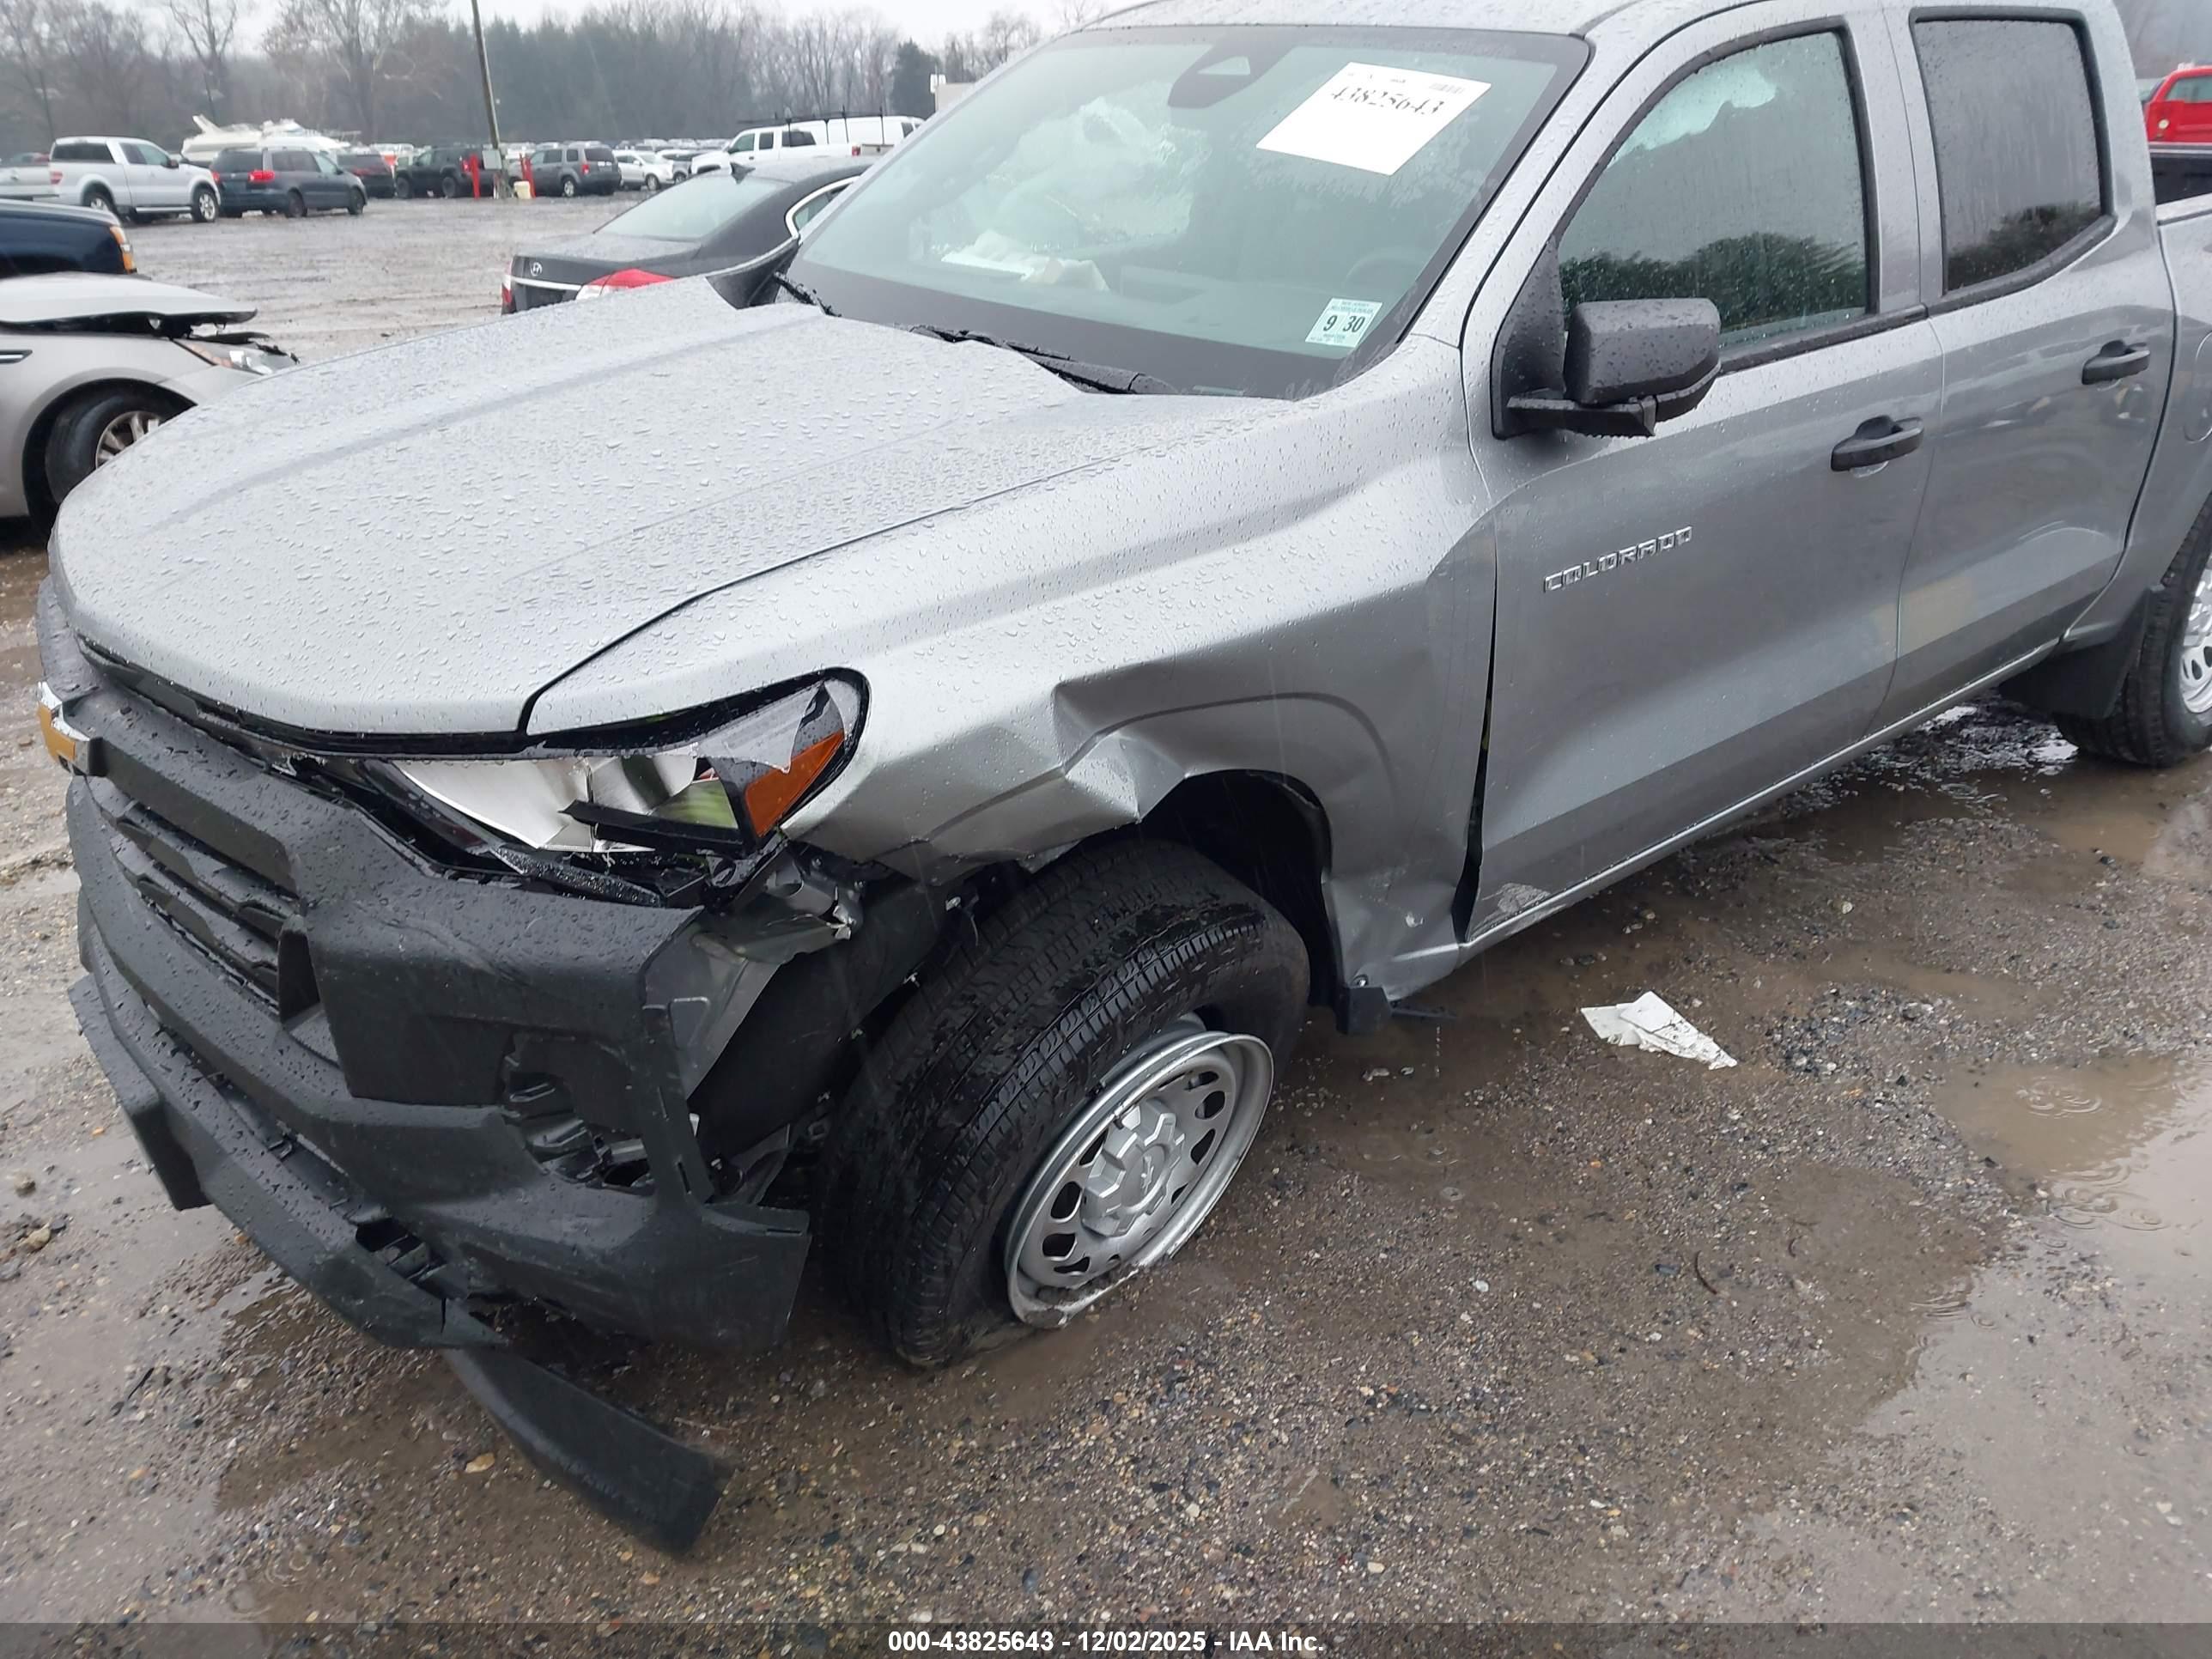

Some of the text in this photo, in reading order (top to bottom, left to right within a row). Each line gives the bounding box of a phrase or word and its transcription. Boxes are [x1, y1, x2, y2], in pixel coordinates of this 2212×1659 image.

[1331, 87, 1444, 114] 43825643
[1323, 315, 1365, 333] 9 30
[1544, 526, 1692, 592] COLORADO
